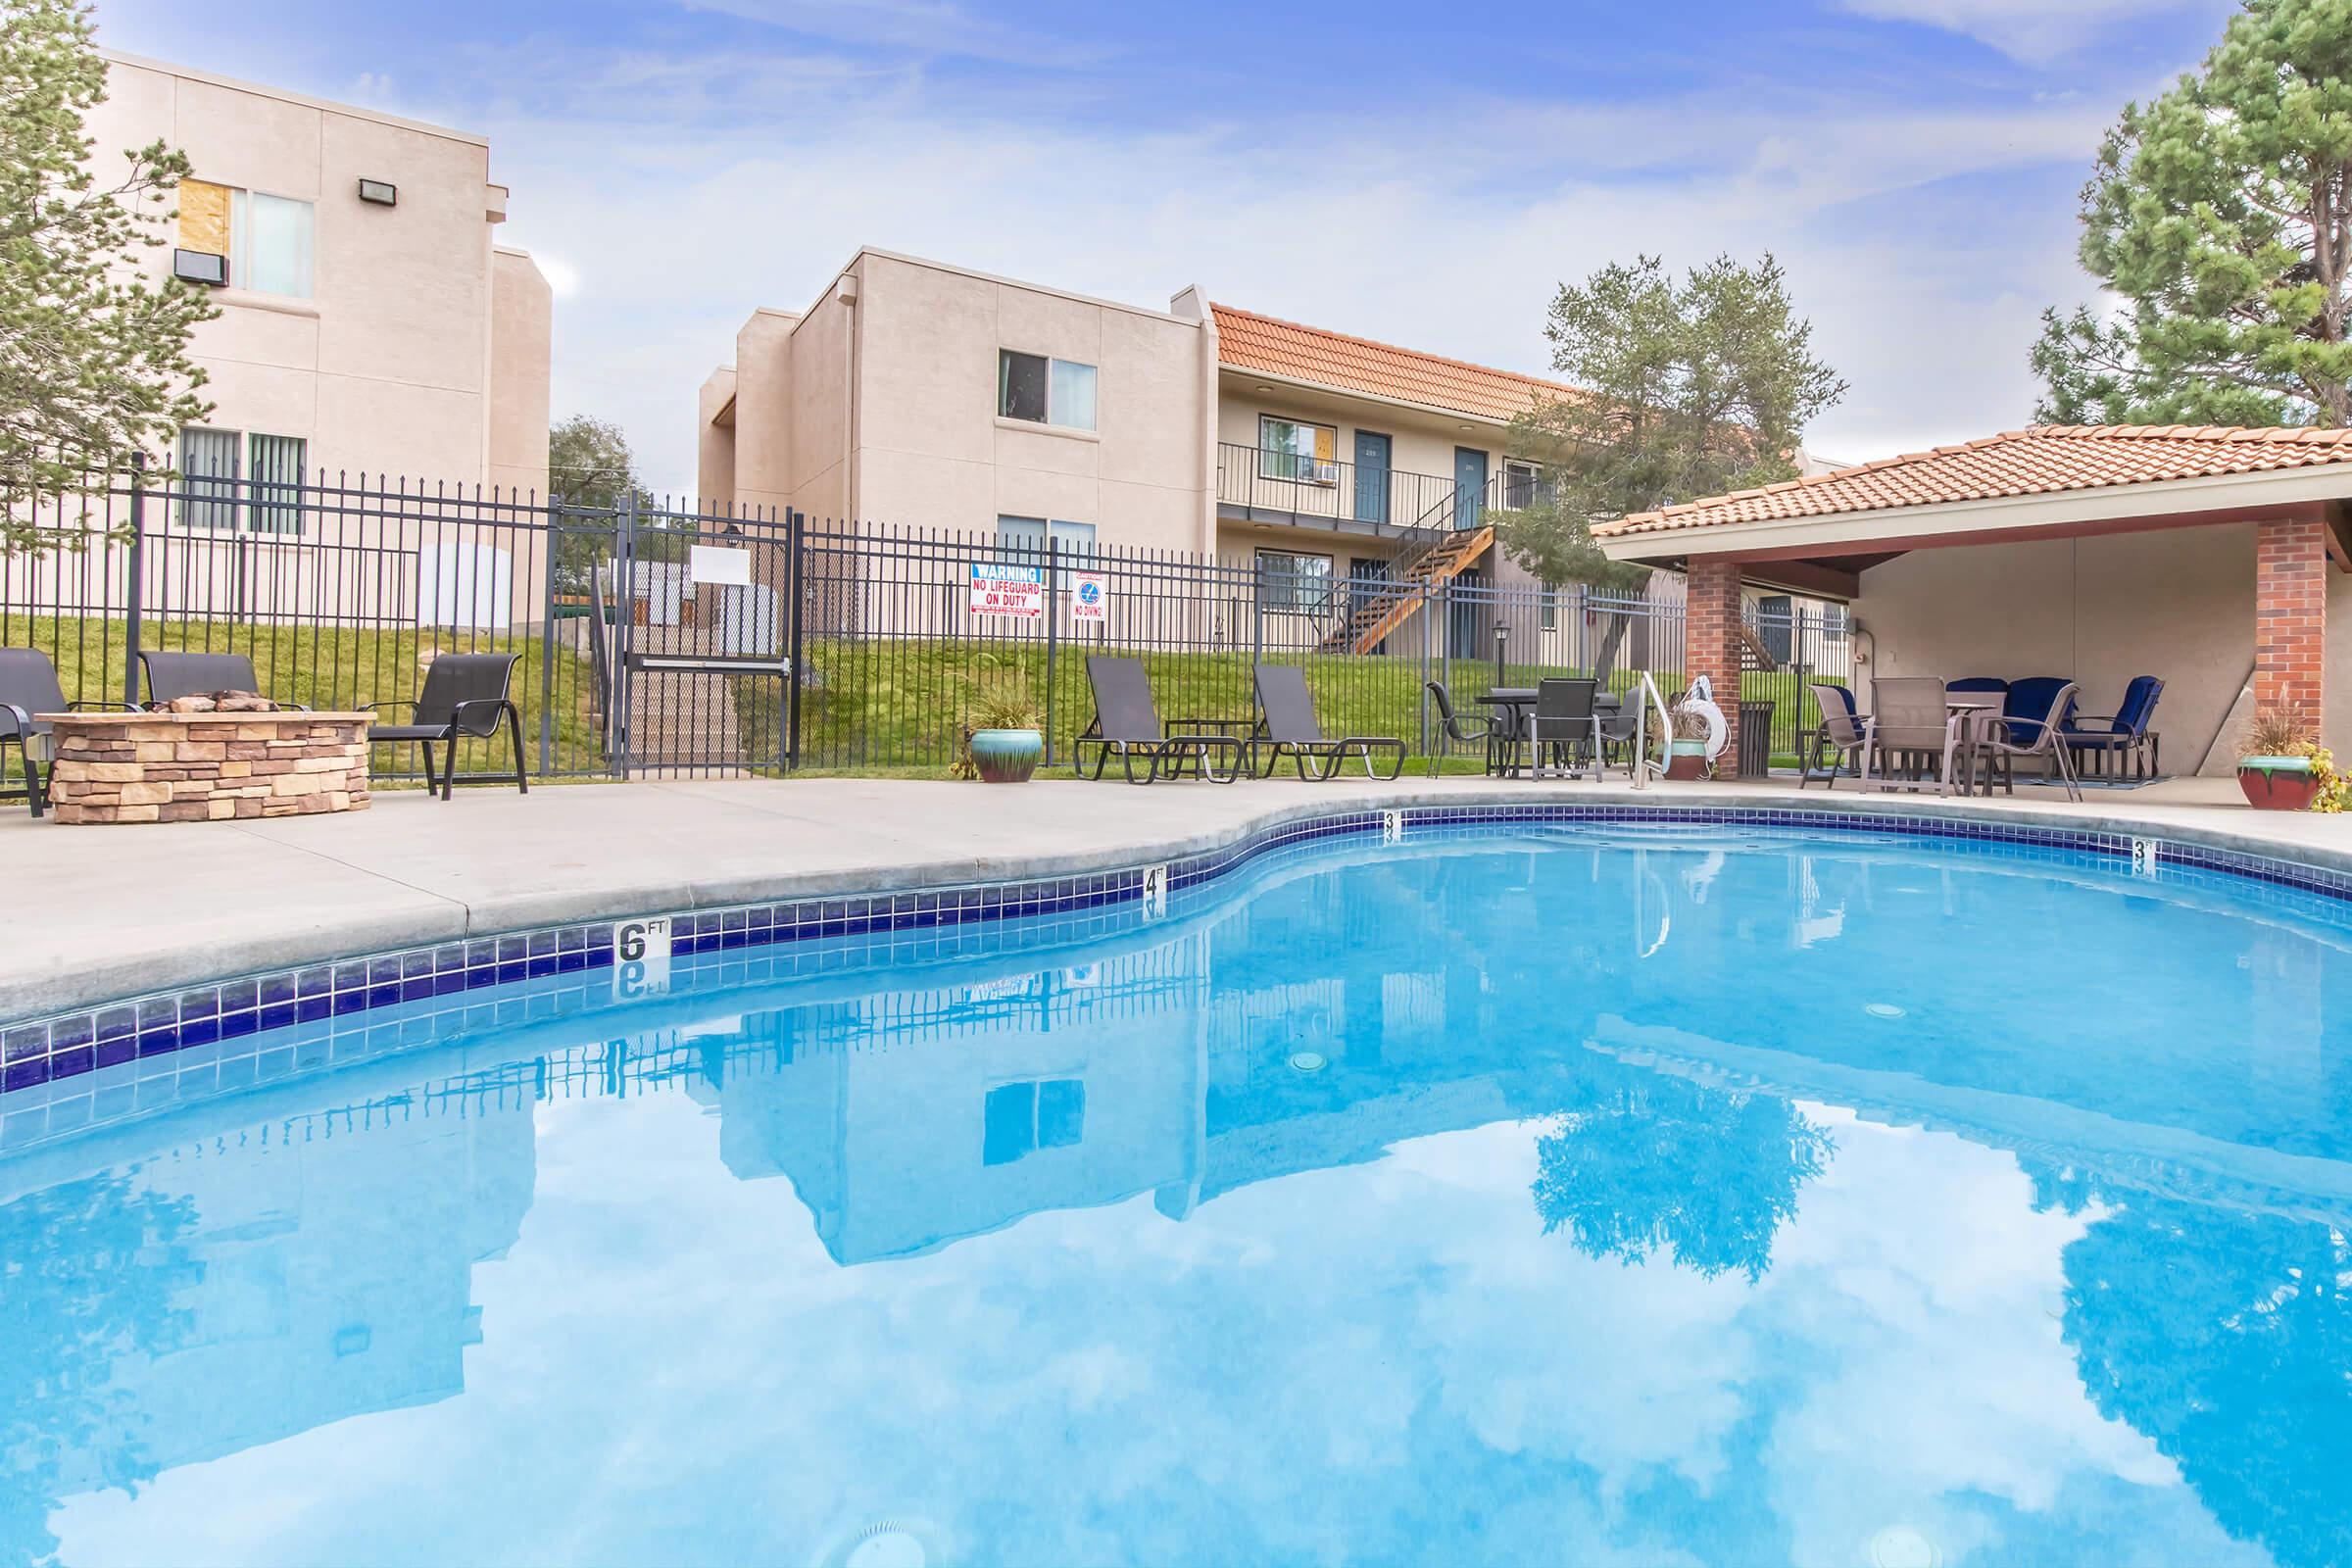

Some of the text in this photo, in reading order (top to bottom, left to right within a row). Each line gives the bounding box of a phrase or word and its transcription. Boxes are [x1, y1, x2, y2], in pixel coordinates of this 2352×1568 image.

[976, 564, 1037, 581] WARNING
[973, 578, 1040, 595] NO LIFEGUARD
[986, 593, 1027, 607] ON DUTY
[1075, 606, 1082, 615] NO
[1386, 812, 1394, 829] 3
[2135, 841, 2145, 858] 3
[1147, 869, 1156, 895] 4
[619, 920, 665, 960] 6 FT
